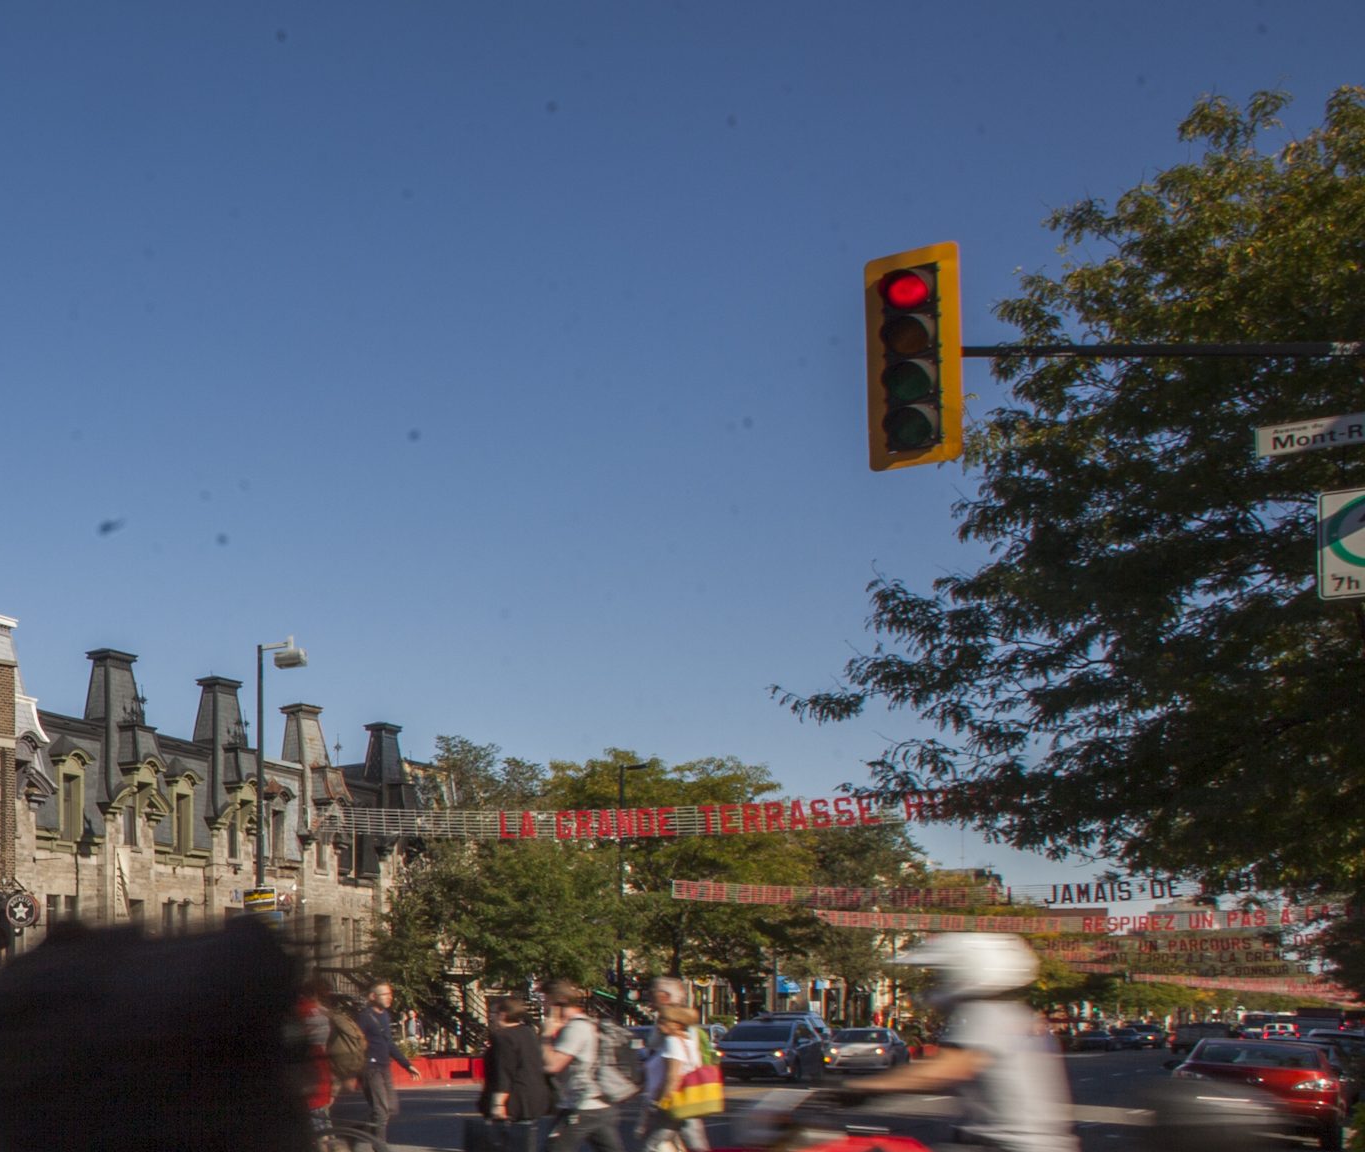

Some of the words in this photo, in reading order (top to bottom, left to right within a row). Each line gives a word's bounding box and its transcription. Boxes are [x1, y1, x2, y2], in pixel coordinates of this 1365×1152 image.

[499, 811, 536, 839] LA
[555, 807, 677, 839] GRANDE
[698, 796, 883, 836] TERRASSE
[1044, 881, 1132, 904] JAMAIS
[1150, 879, 1182, 899] DE
[1082, 915, 1176, 933] RESPIREZ
[1189, 913, 1214, 930] UN
[1227, 910, 1266, 928] PAS
[1138, 938, 1158, 954] UN
[1167, 937, 1252, 953] PARCOURS
[1235, 964, 1289, 976] BONHEUR
